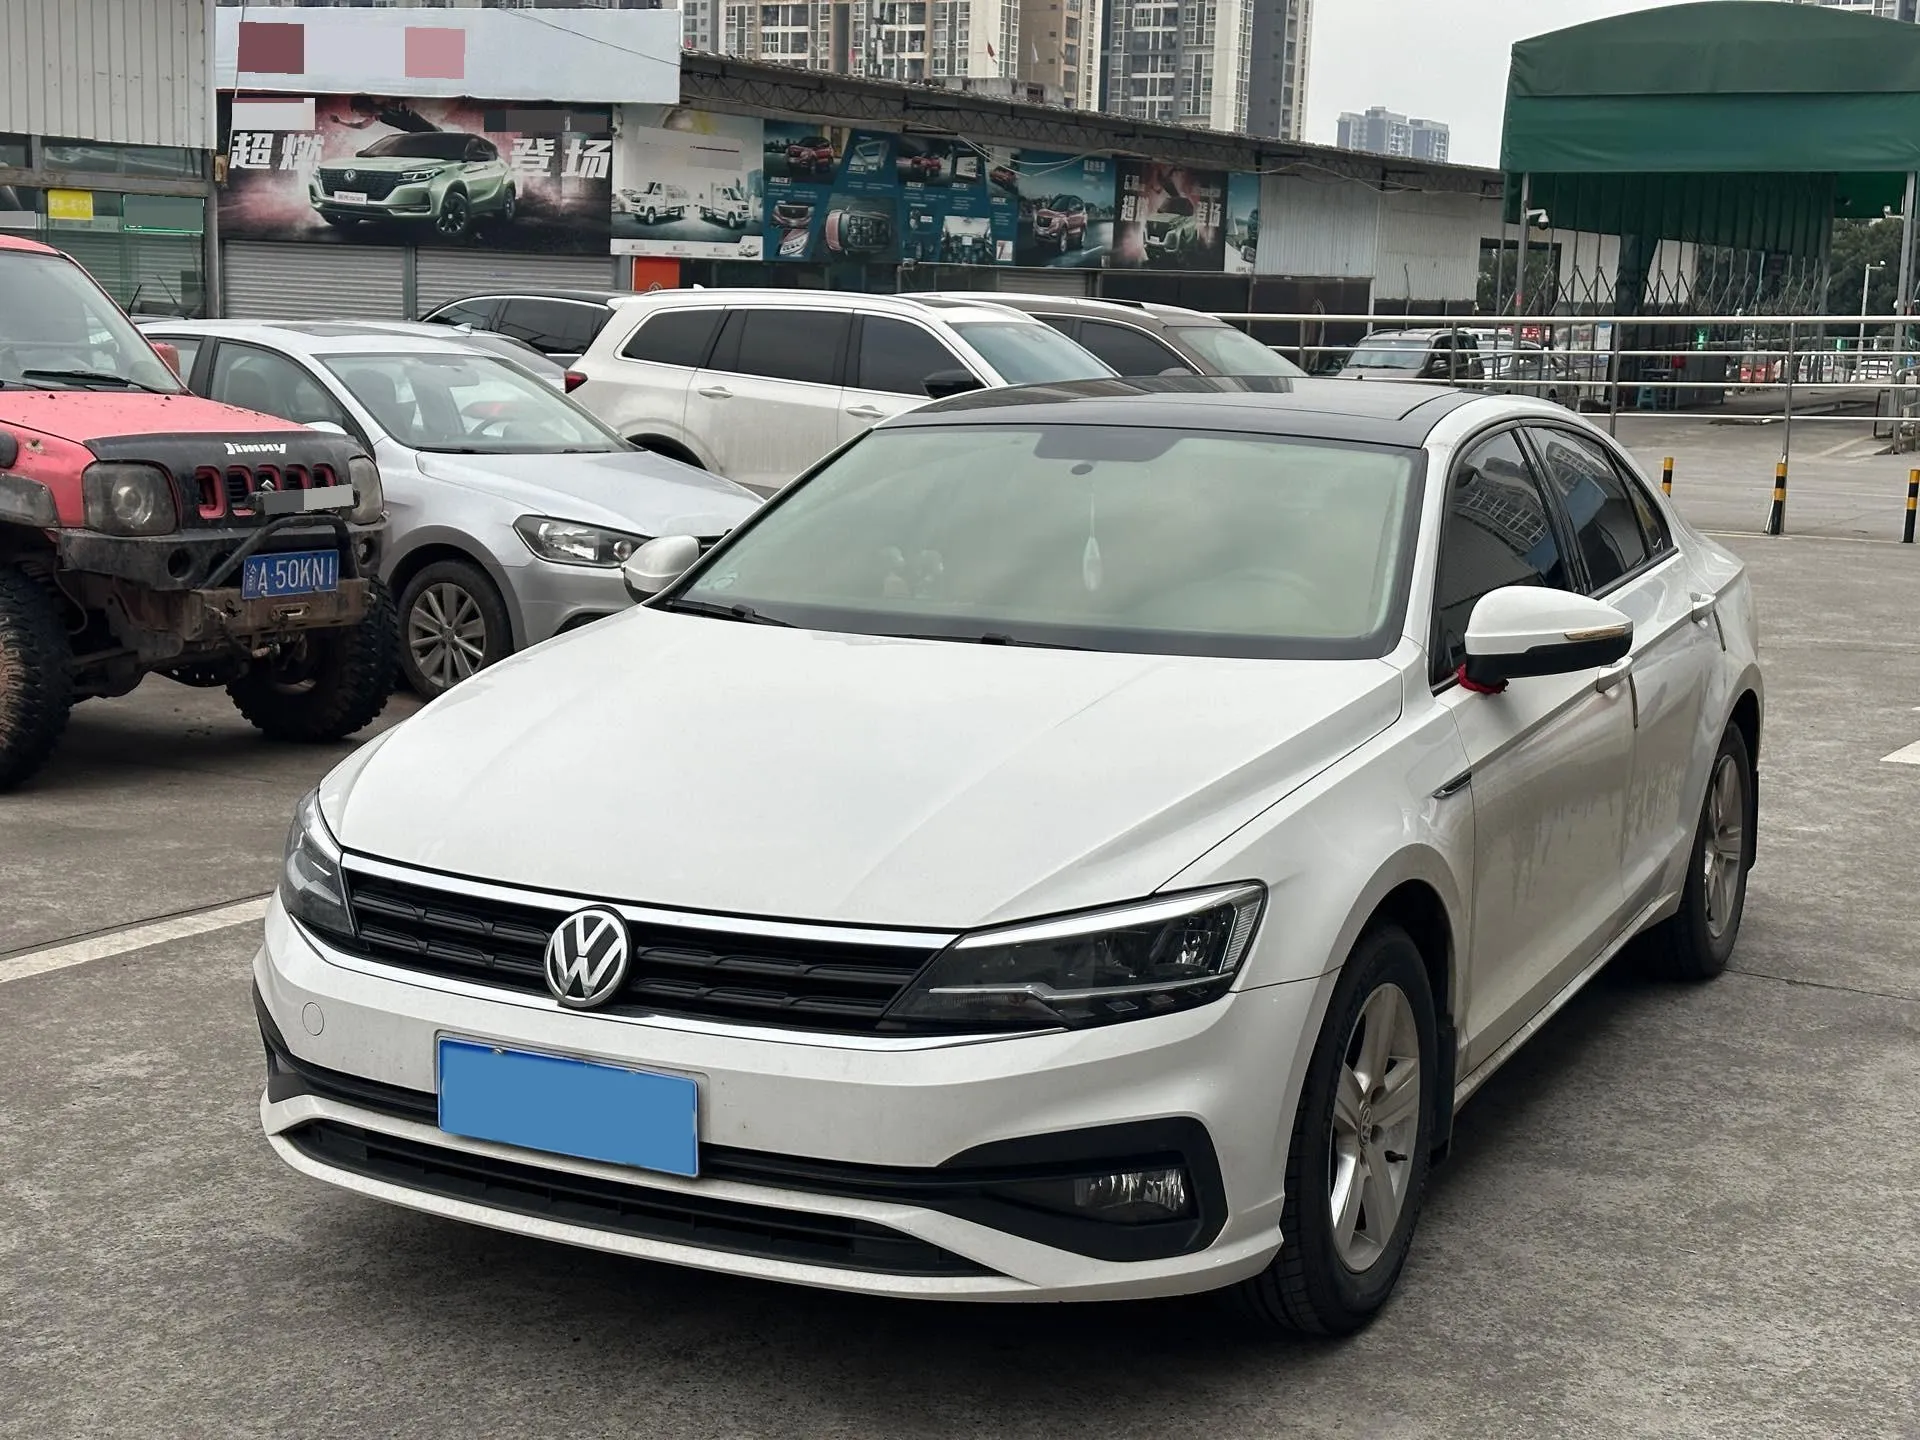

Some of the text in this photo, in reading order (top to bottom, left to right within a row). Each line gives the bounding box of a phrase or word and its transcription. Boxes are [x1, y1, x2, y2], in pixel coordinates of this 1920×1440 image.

[230, 133, 612, 178] 超燃 登场
[223, 443, 287, 455] Jimny
[548, 910, 627, 1001] VW
